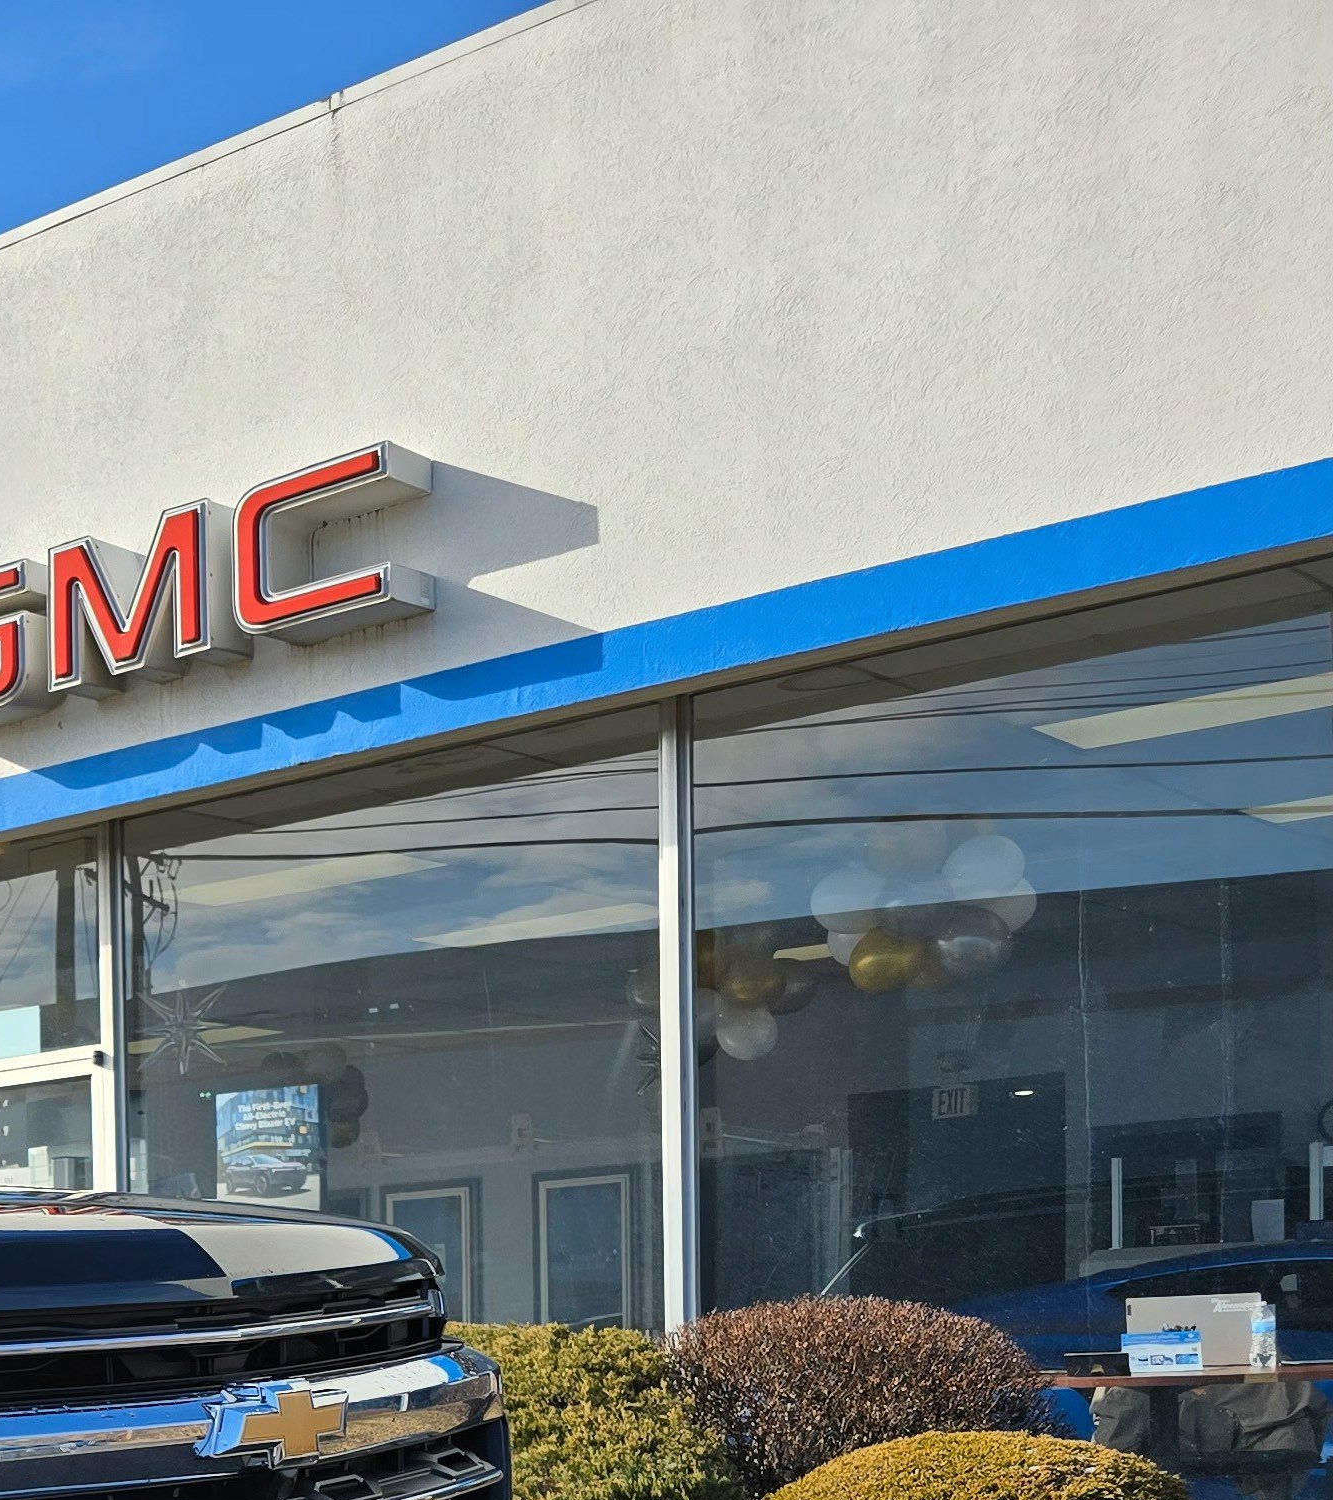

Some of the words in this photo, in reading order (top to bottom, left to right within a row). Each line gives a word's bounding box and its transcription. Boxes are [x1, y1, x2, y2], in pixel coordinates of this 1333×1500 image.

[938, 1088, 964, 1116] EXIT
[237, 1105, 252, 1113] The
[243, 1110, 286, 1121] All-Electric
[284, 1117, 297, 1126] EV
